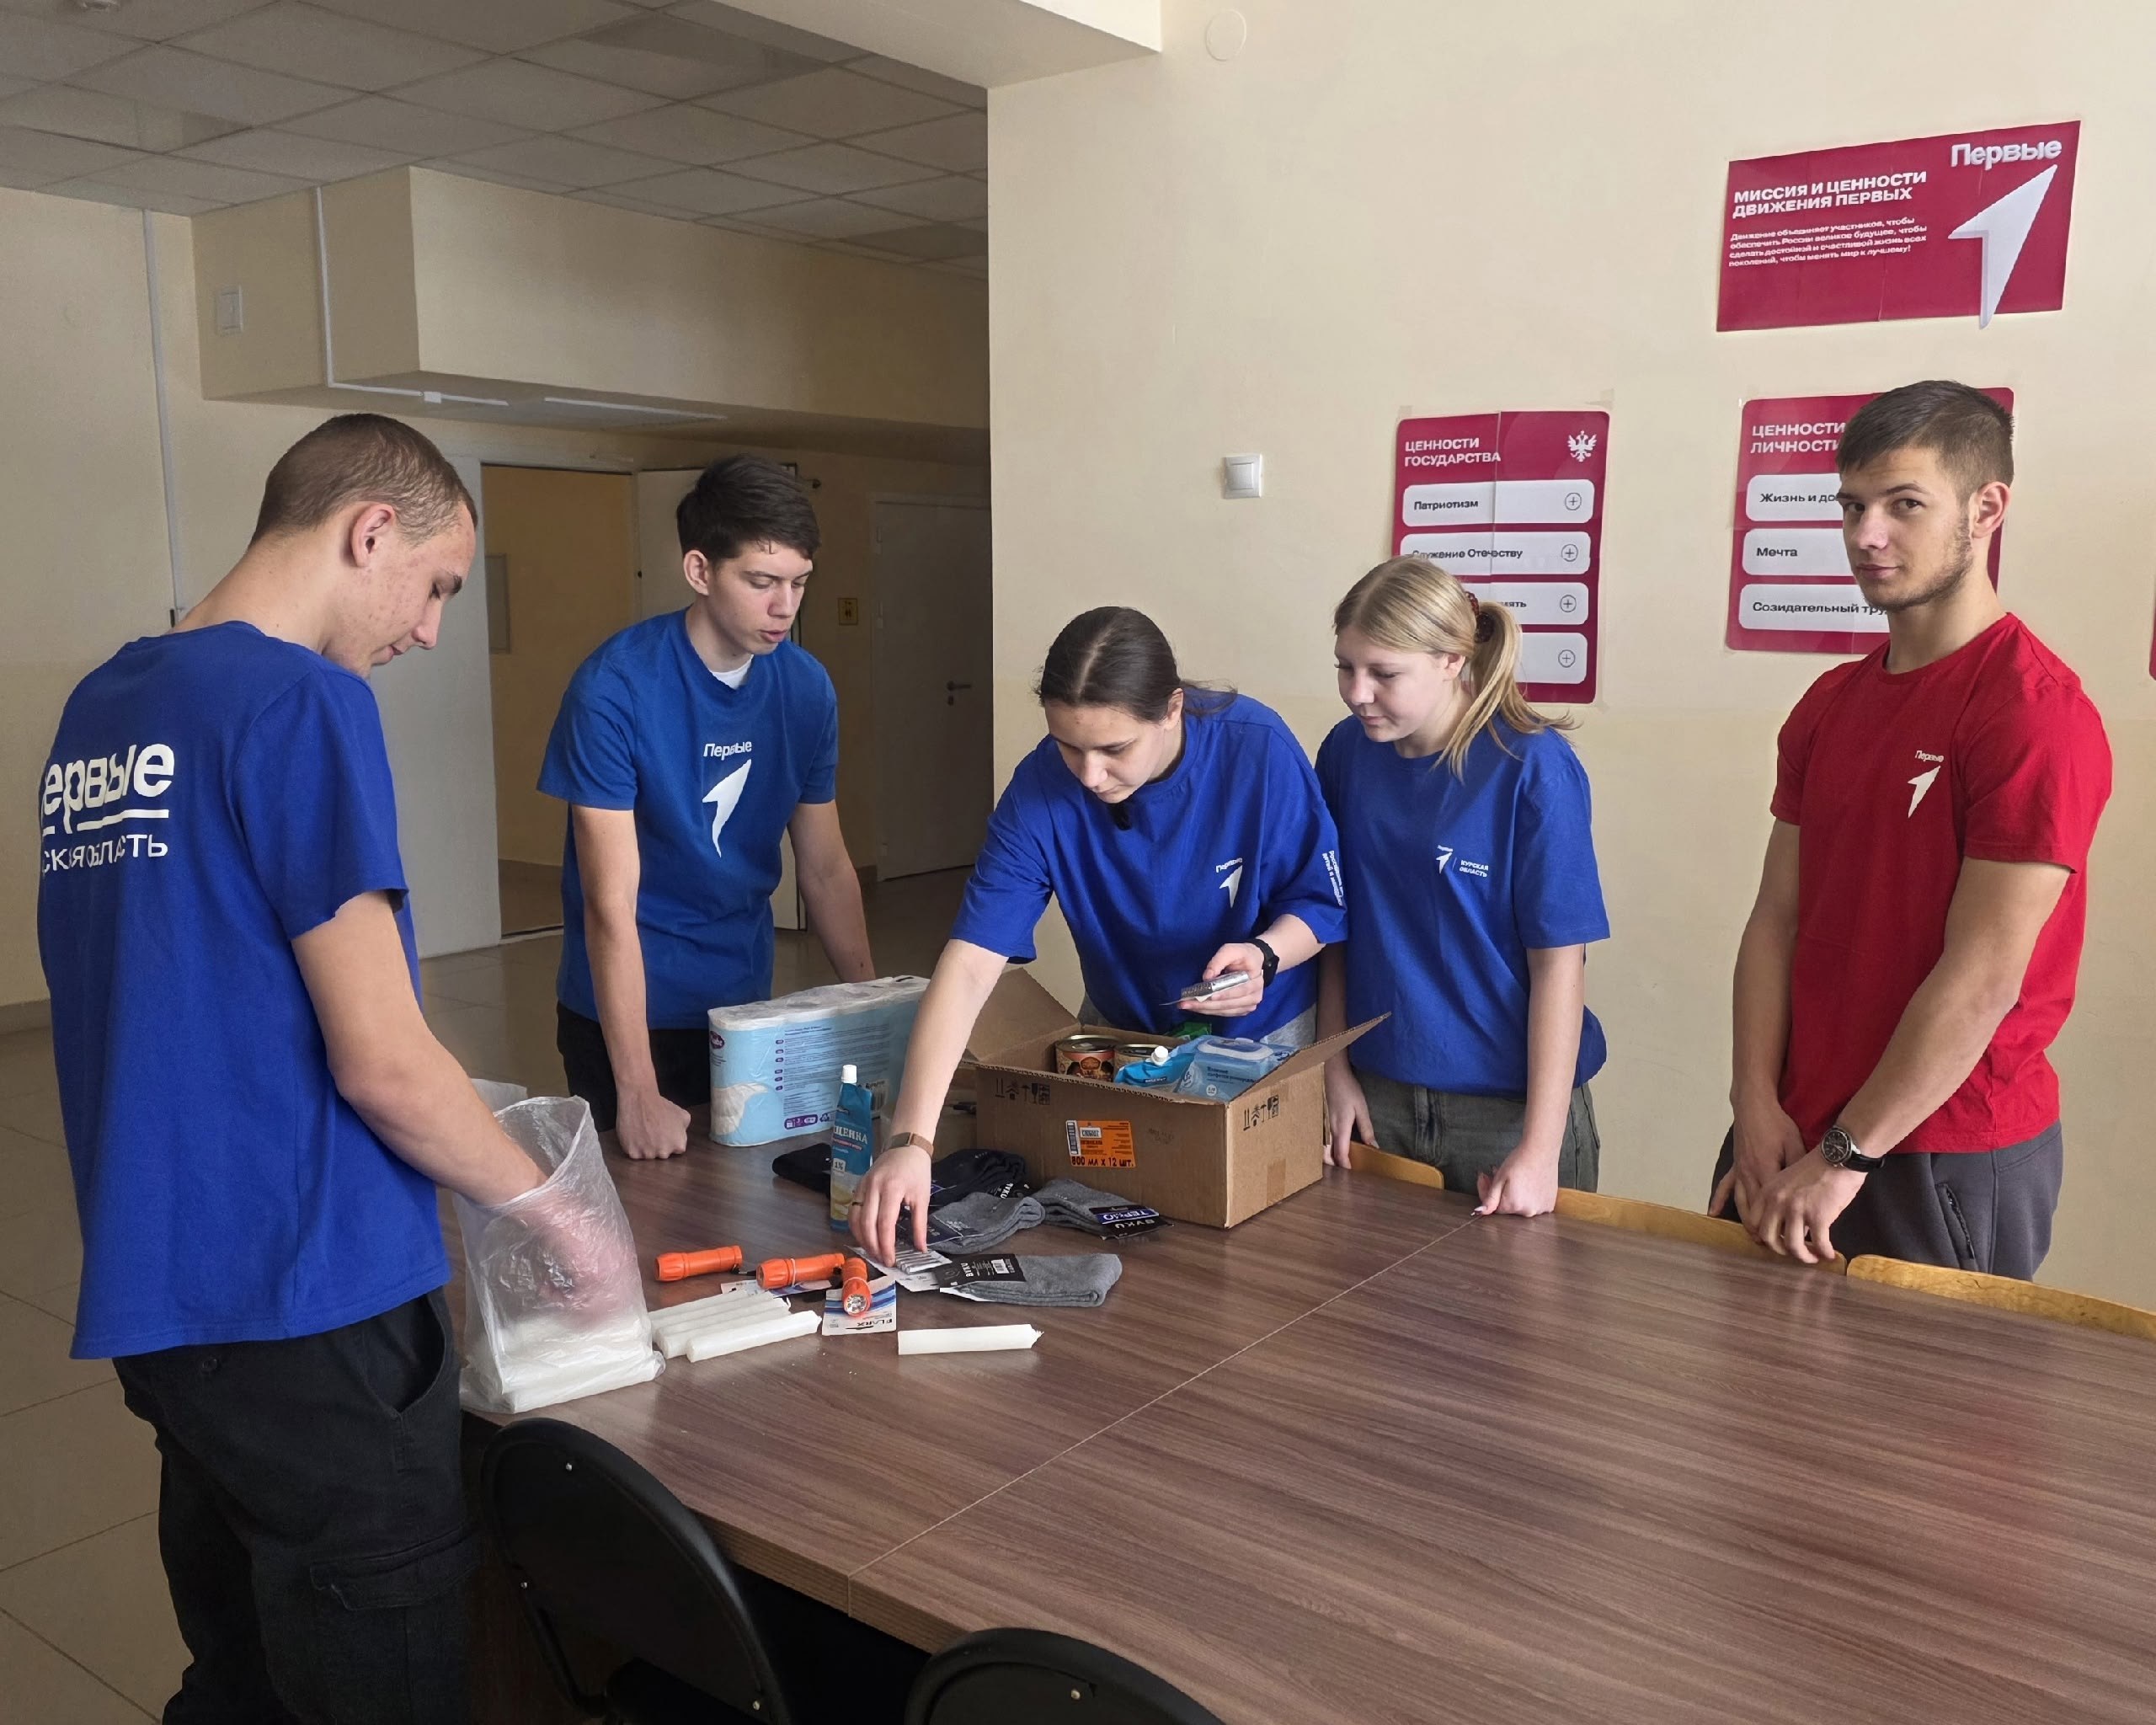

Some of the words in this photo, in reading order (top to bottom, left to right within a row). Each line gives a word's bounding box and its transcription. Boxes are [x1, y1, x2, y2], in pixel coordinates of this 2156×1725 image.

[1951, 140, 2063, 171] Первые
[1734, 184, 1808, 204] МИССИЯ
[1811, 182, 1824, 195] И
[1826, 171, 1927, 195] ЦЕННОСТИ
[1732, 195, 1833, 219] ДВИЖЕНИЯ
[1835, 187, 1913, 206] ПЕРВЫХ
[1886, 216, 1915, 227] чтобы
[1898, 225, 1928, 235] чтобы
[1752, 422, 1847, 437] ЦЕННОСТИ
[1405, 437, 1481, 453] ЦЕННОСТИ
[1404, 451, 1502, 467] ГОСУДАРСТВА
[1413, 499, 1480, 510] Патриотизм
[1759, 493, 1806, 503] Жизнь
[1818, 494, 1838, 504] до
[1467, 548, 1524, 559] Отечеству
[1756, 547, 1799, 557] Мечта
[1753, 601, 1860, 614] Созидательный
[702, 740, 753, 761] Первые
[42, 743, 175, 834] ервые
[1460, 859, 1489, 871] КУРСКАЯ
[1459, 867, 1487, 878] ОБЛАСТЬ
[1071, 1156, 1086, 1166] 800
[1107, 1157, 1117, 1167] 12
